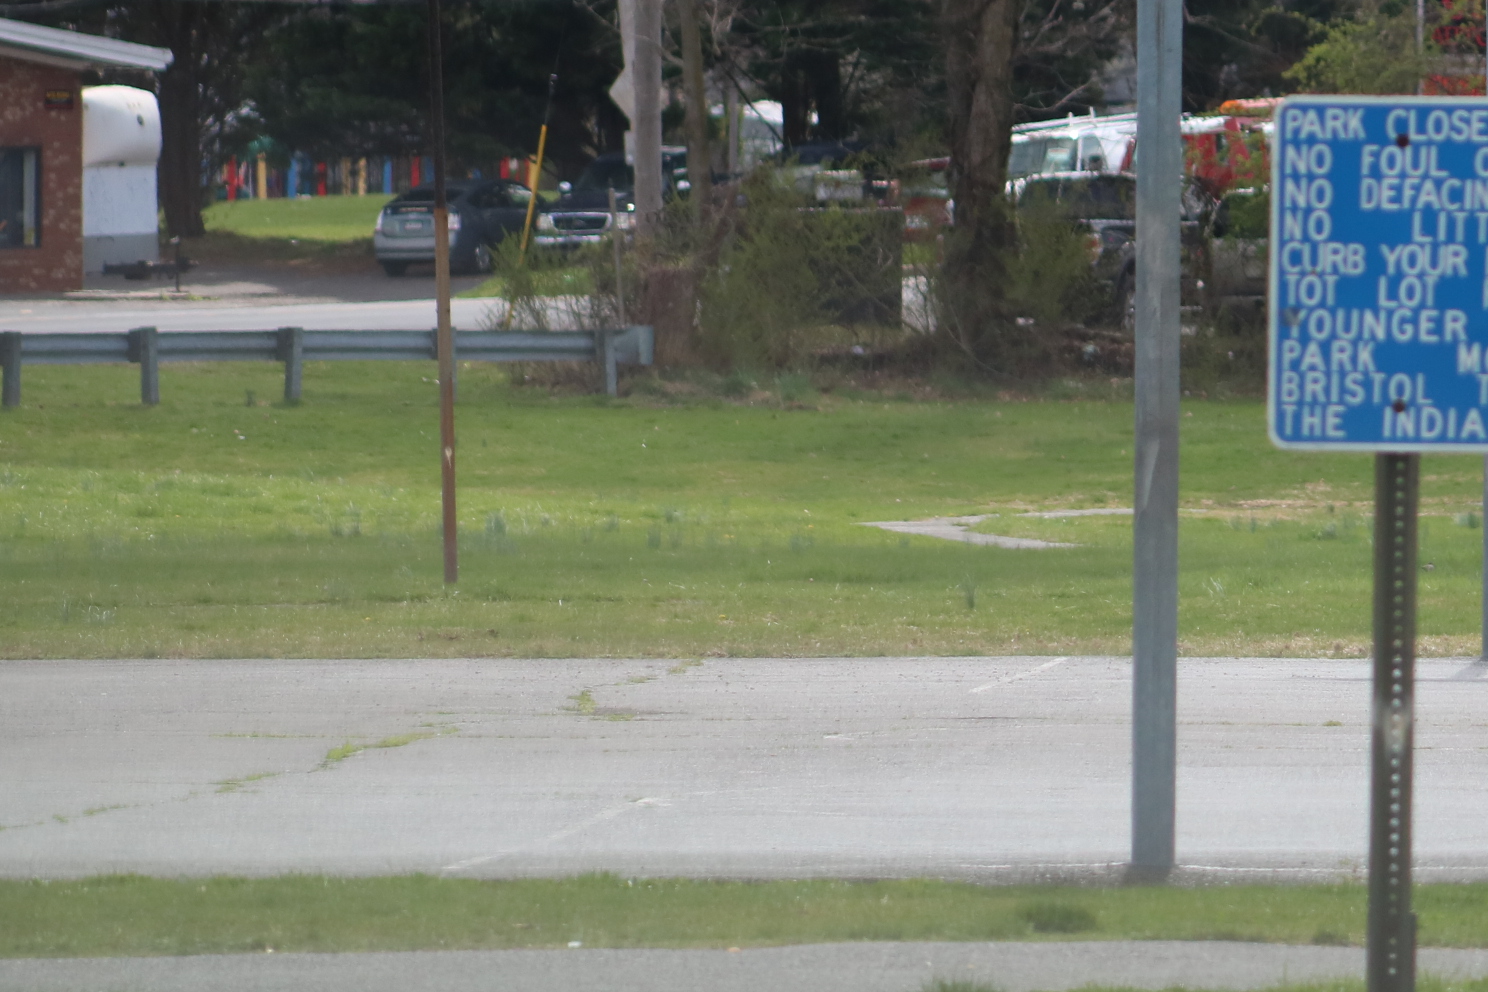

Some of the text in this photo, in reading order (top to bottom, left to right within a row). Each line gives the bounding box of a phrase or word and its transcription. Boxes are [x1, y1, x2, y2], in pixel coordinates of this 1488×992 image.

[1285, 109, 1366, 140] PARK
[1285, 144, 1332, 175] NO
[1361, 145, 1449, 177] FOUL
[1285, 178, 1332, 208] NO
[1284, 210, 1331, 241] NO
[1282, 242, 1365, 274] CURB
[1380, 244, 1468, 276] YOUR
[1285, 274, 1339, 307] TOT
[1379, 275, 1438, 308] LOT
[1285, 308, 1468, 343] YOUNGER
[1282, 339, 1376, 372] PARK
[1282, 371, 1433, 405] BRISTOL
[1282, 405, 1347, 437] THE
